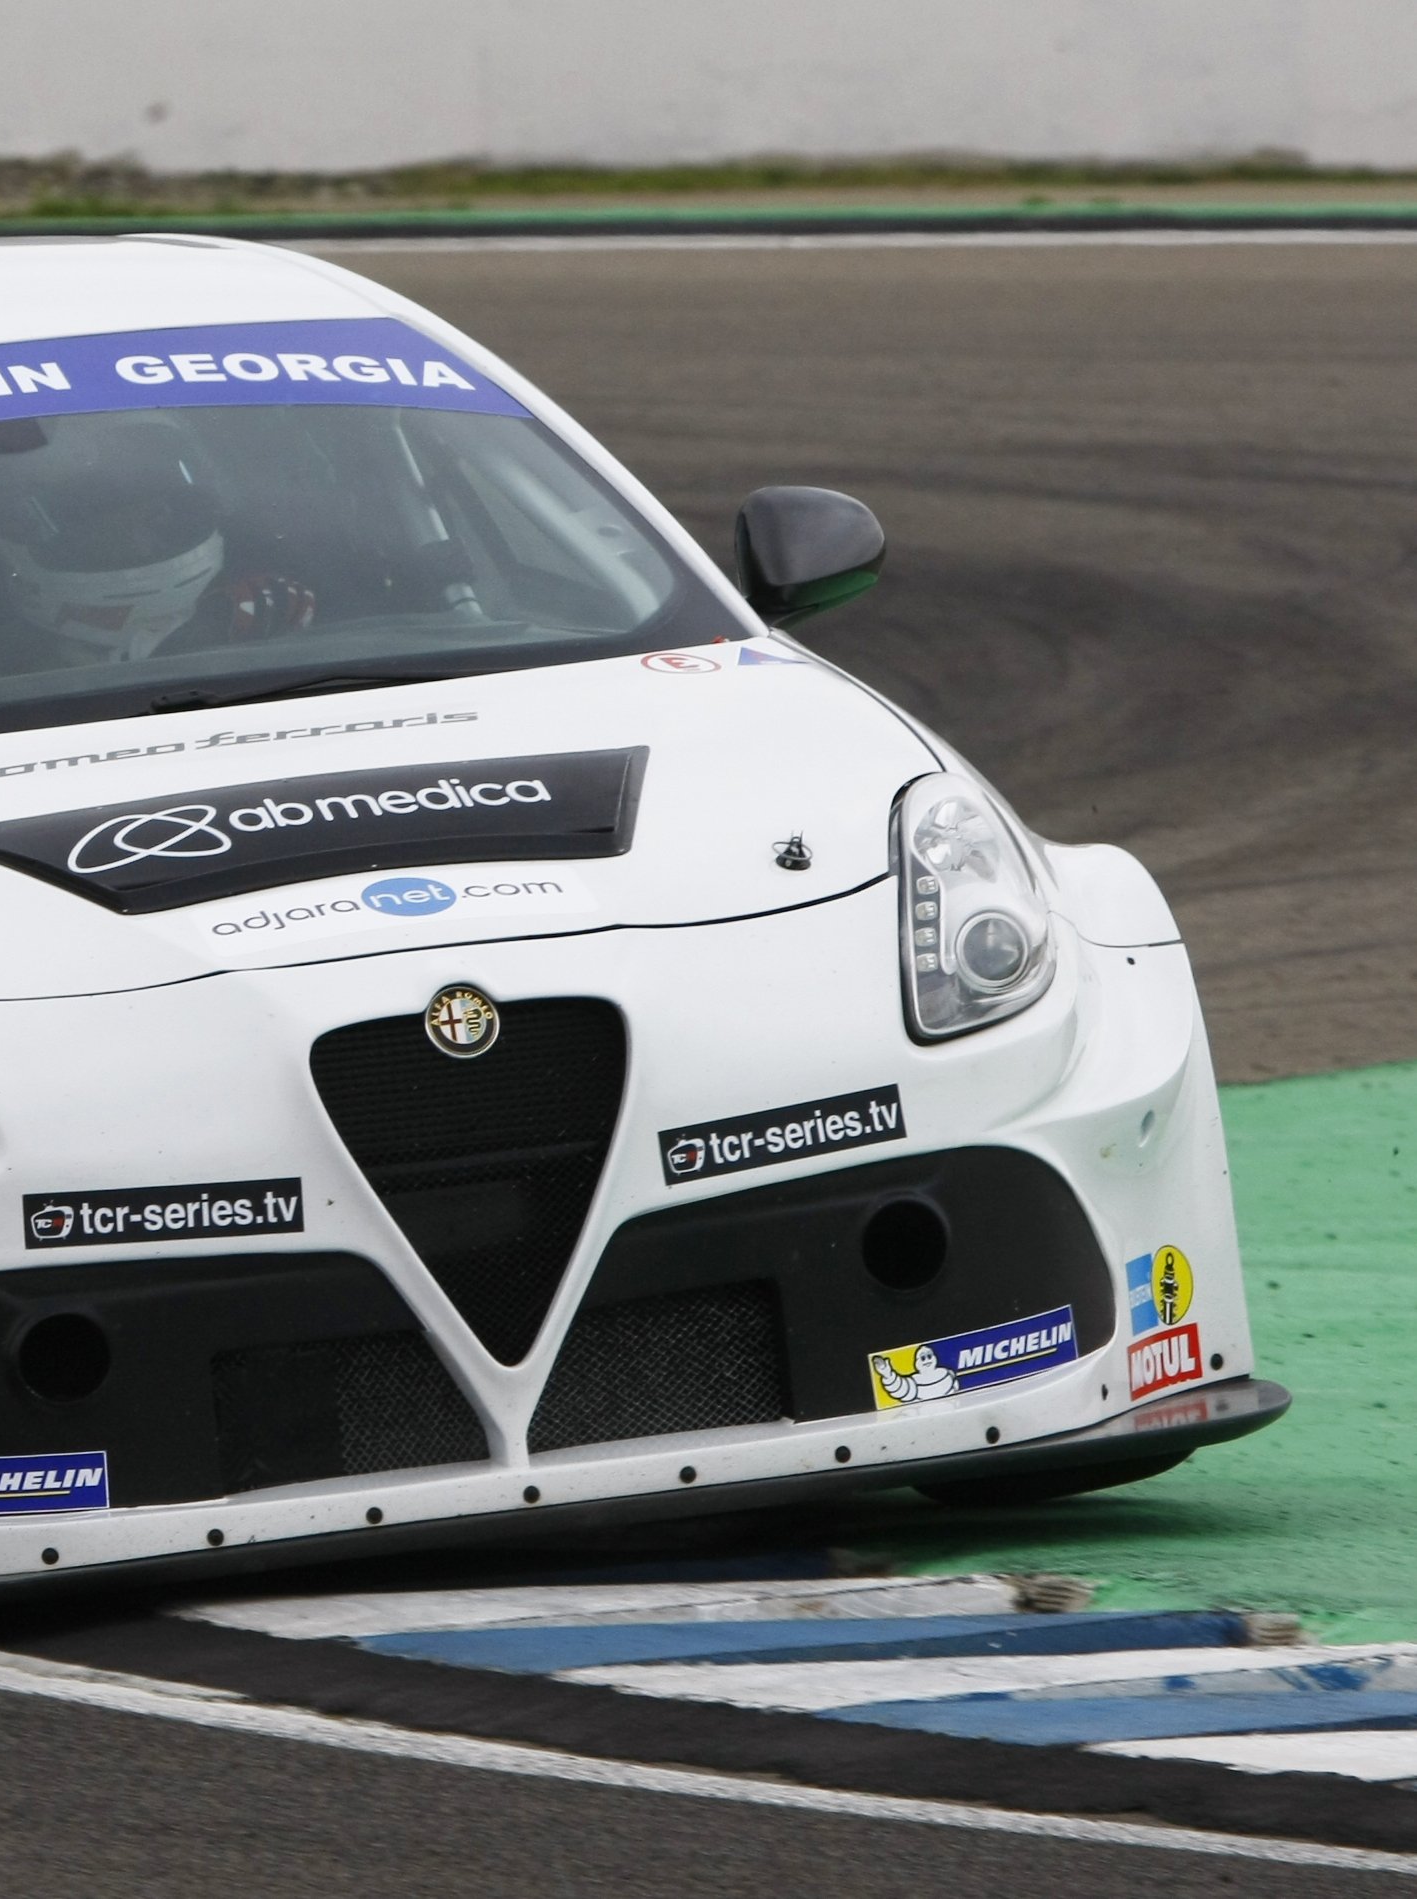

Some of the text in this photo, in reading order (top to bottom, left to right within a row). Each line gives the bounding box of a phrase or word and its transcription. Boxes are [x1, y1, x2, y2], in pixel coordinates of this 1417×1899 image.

[114, 352, 477, 392] GEORGIA
[194, 711, 479, 750] ferraris
[211, 876, 564, 938] adjaranet.com
[708, 1100, 899, 1165] tcr-series.tv
[79, 1191, 299, 1235] tcr-series.tv
[957, 1320, 1073, 1371] MICHELIN
[1131, 1332, 1196, 1392] MOTUL
